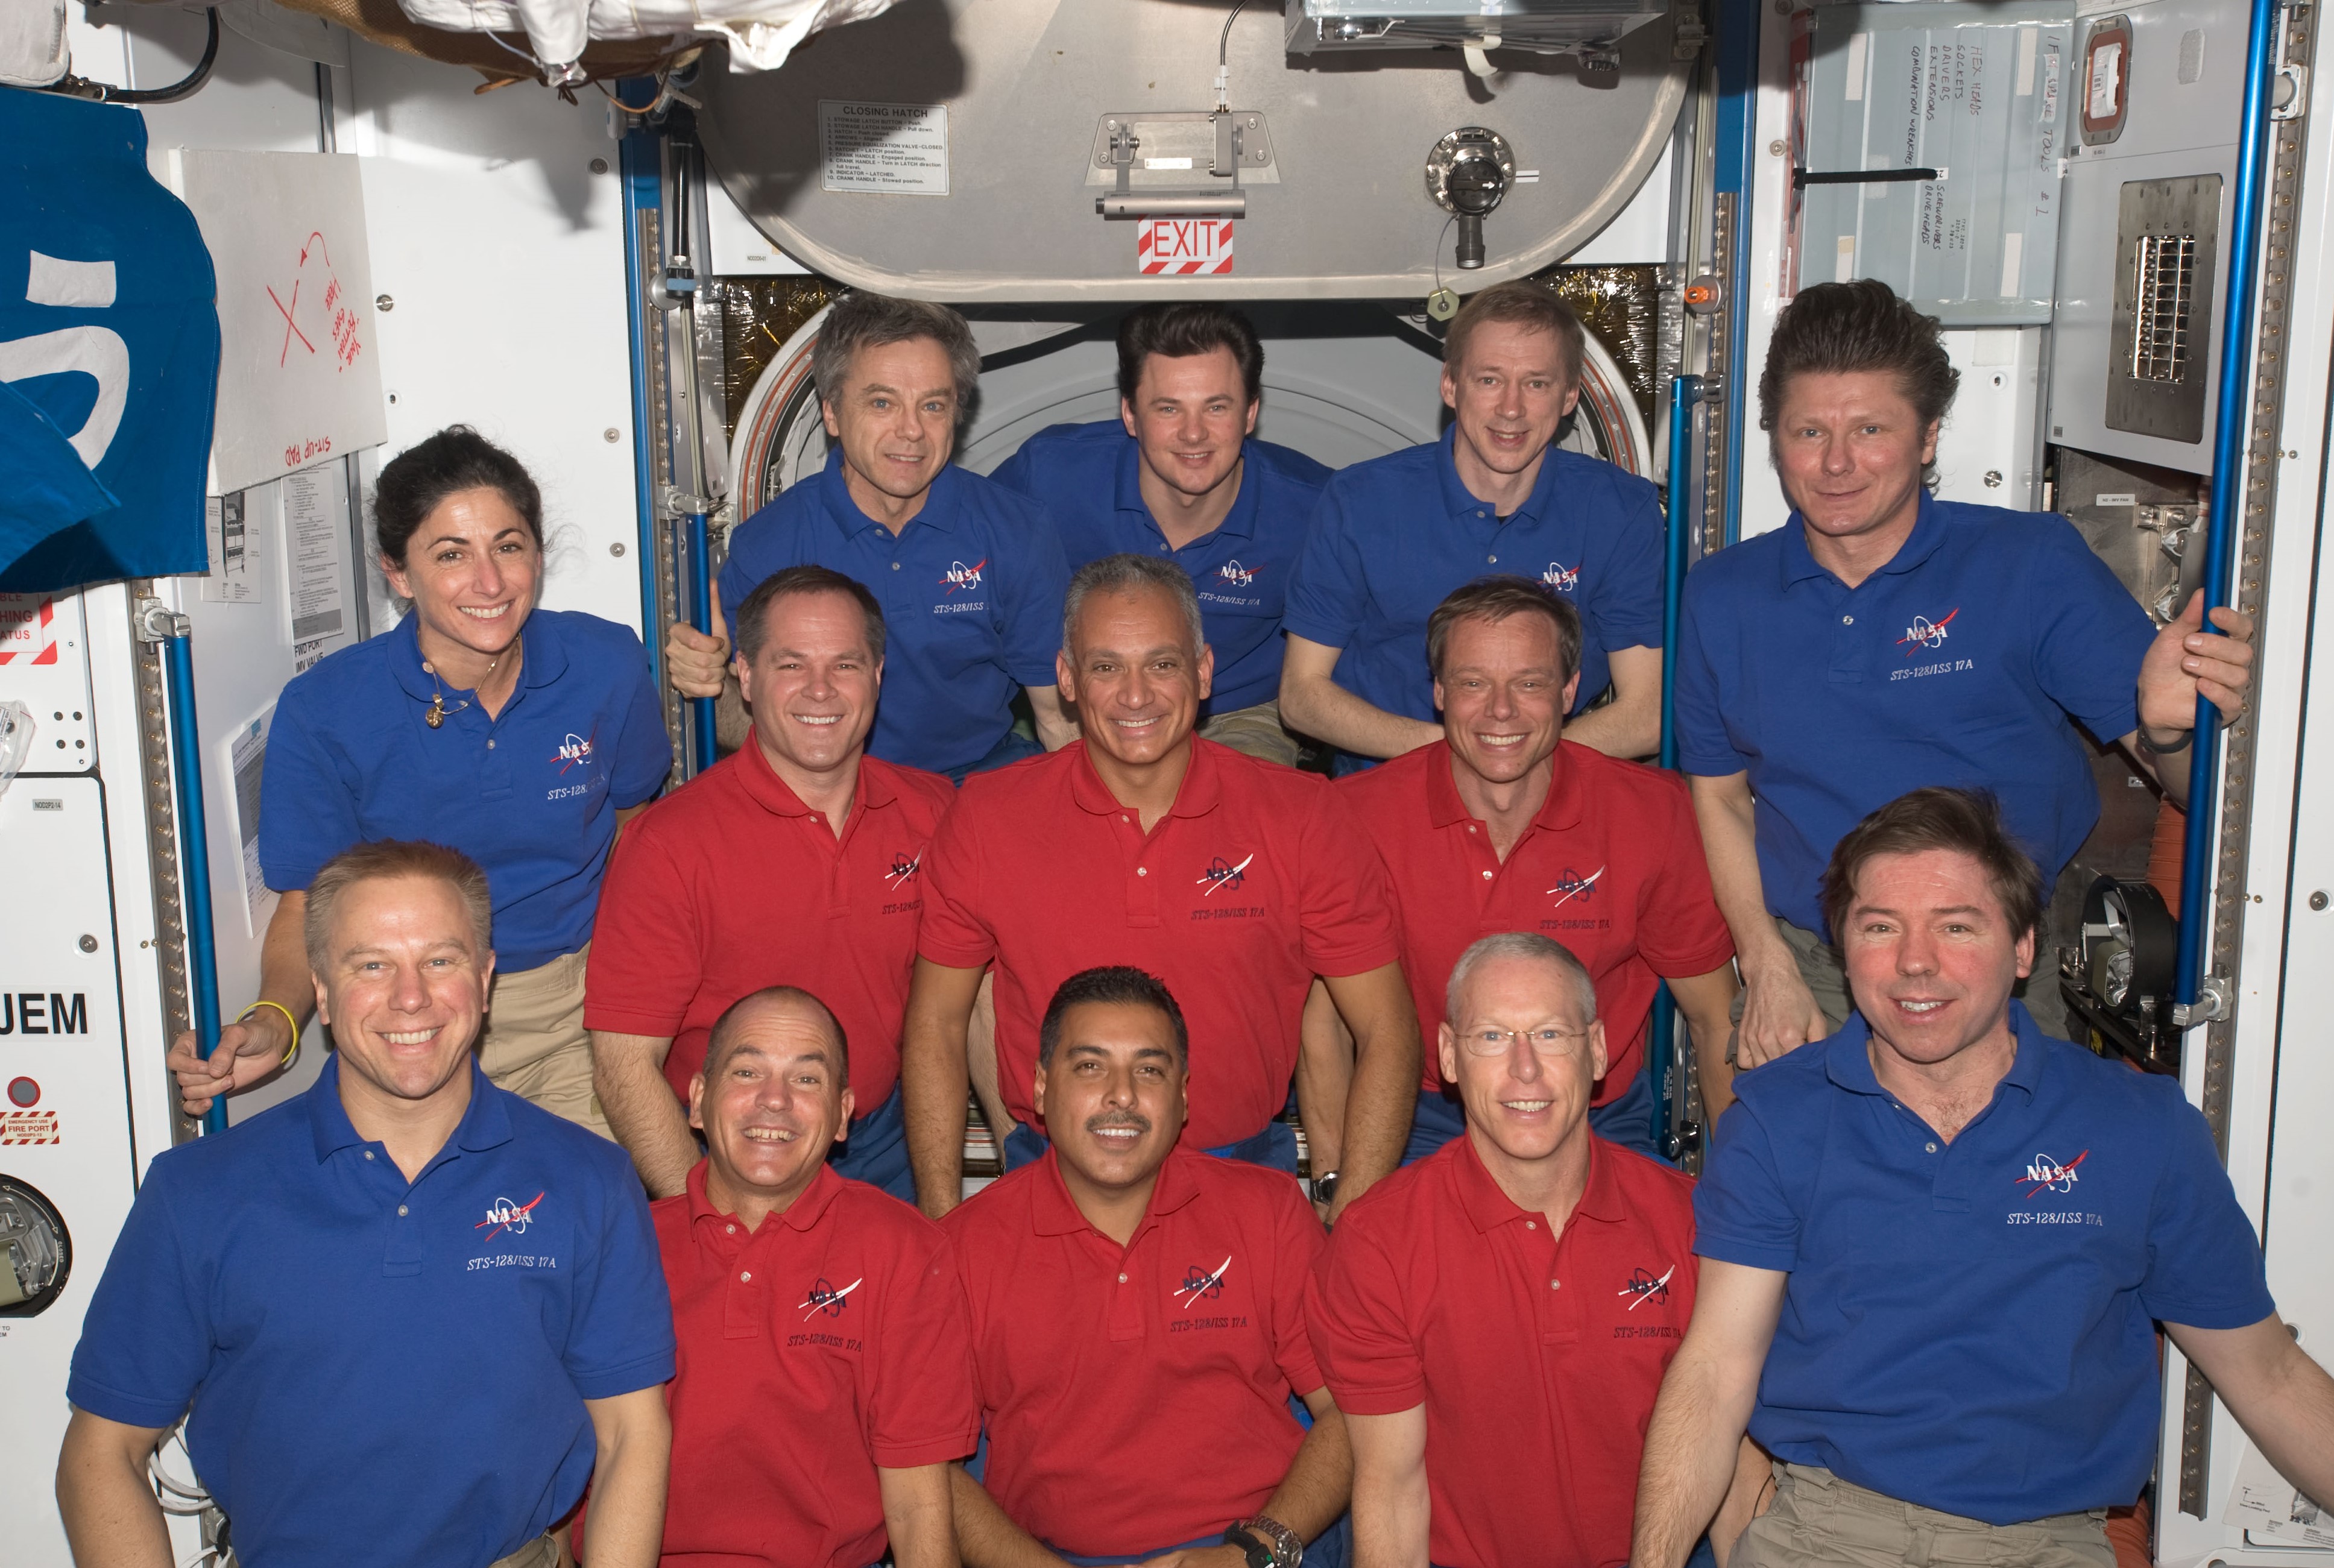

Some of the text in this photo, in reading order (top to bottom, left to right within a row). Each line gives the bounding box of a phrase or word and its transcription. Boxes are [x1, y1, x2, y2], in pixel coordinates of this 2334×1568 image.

[1940, 45, 1952, 101] DRIVERS
[1955, 45, 1965, 99] SOCKETS
[1926, 46, 1938, 121] EXTENSIONS
[1969, 46, 1982, 116] HEX HEADS
[843, 106, 928, 118] CLOSING HATCH
[1905, 46, 1921, 165] COMBINATION WRENCHES
[2041, 129, 2052, 173] TOOLS
[1933, 184, 1945, 250] SCREWDRIVERS
[1153, 221, 1218, 257] EXIT
[346, 334, 361, 365] YOUR
[286, 444, 301, 467] PAD
[947, 570, 982, 582] NASA
[1220, 566, 1252, 582] NASA
[1543, 571, 1579, 584] NASA
[1198, 592, 1246, 605] STS-128/ISS
[933, 602, 984, 614] STS-128/ISS
[1907, 625, 1949, 641] NASA
[295, 643, 306, 658] FWD
[296, 656, 306, 673] IMV
[1891, 659, 1974, 681] STS-128/ISS 17A
[559, 741, 591, 759] NAS
[1206, 868, 1245, 881] NASA
[1557, 880, 1597, 893] NASA
[0, 993, 88, 1035] JEM
[2026, 1165, 2079, 1182] NASA
[486, 1207, 534, 1224] NASA
[2007, 1212, 2103, 1226] STS-128/ISS 17A
[467, 1255, 557, 1271] STS-128/ISS 17A
[1182, 1276, 1225, 1291] NASA
[1170, 1317, 1228, 1332] STS-128/ISS
[846, 1339, 862, 1352] 17A
